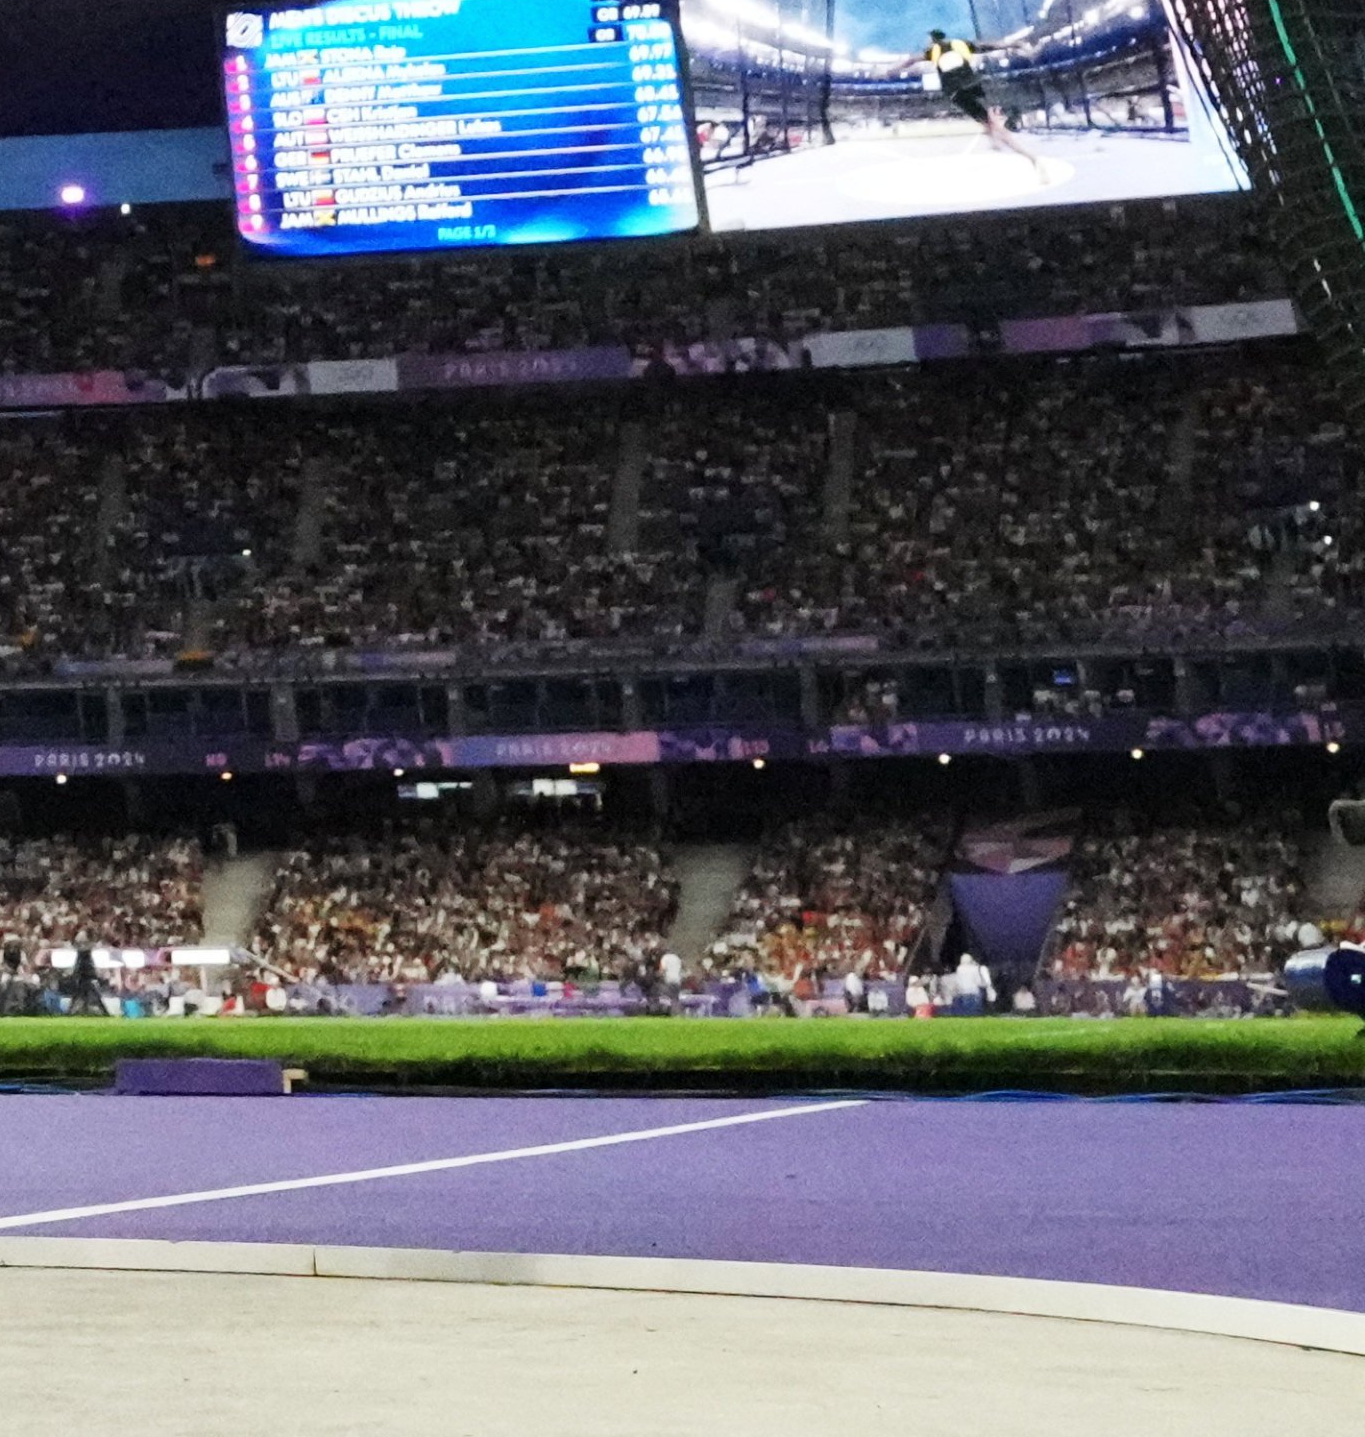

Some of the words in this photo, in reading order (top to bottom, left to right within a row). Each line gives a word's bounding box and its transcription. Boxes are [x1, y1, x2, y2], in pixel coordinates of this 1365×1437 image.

[964, 728, 1027, 744] PARIS
[34, 752, 89, 767] PARIS
[94, 751, 146, 766] 2024
